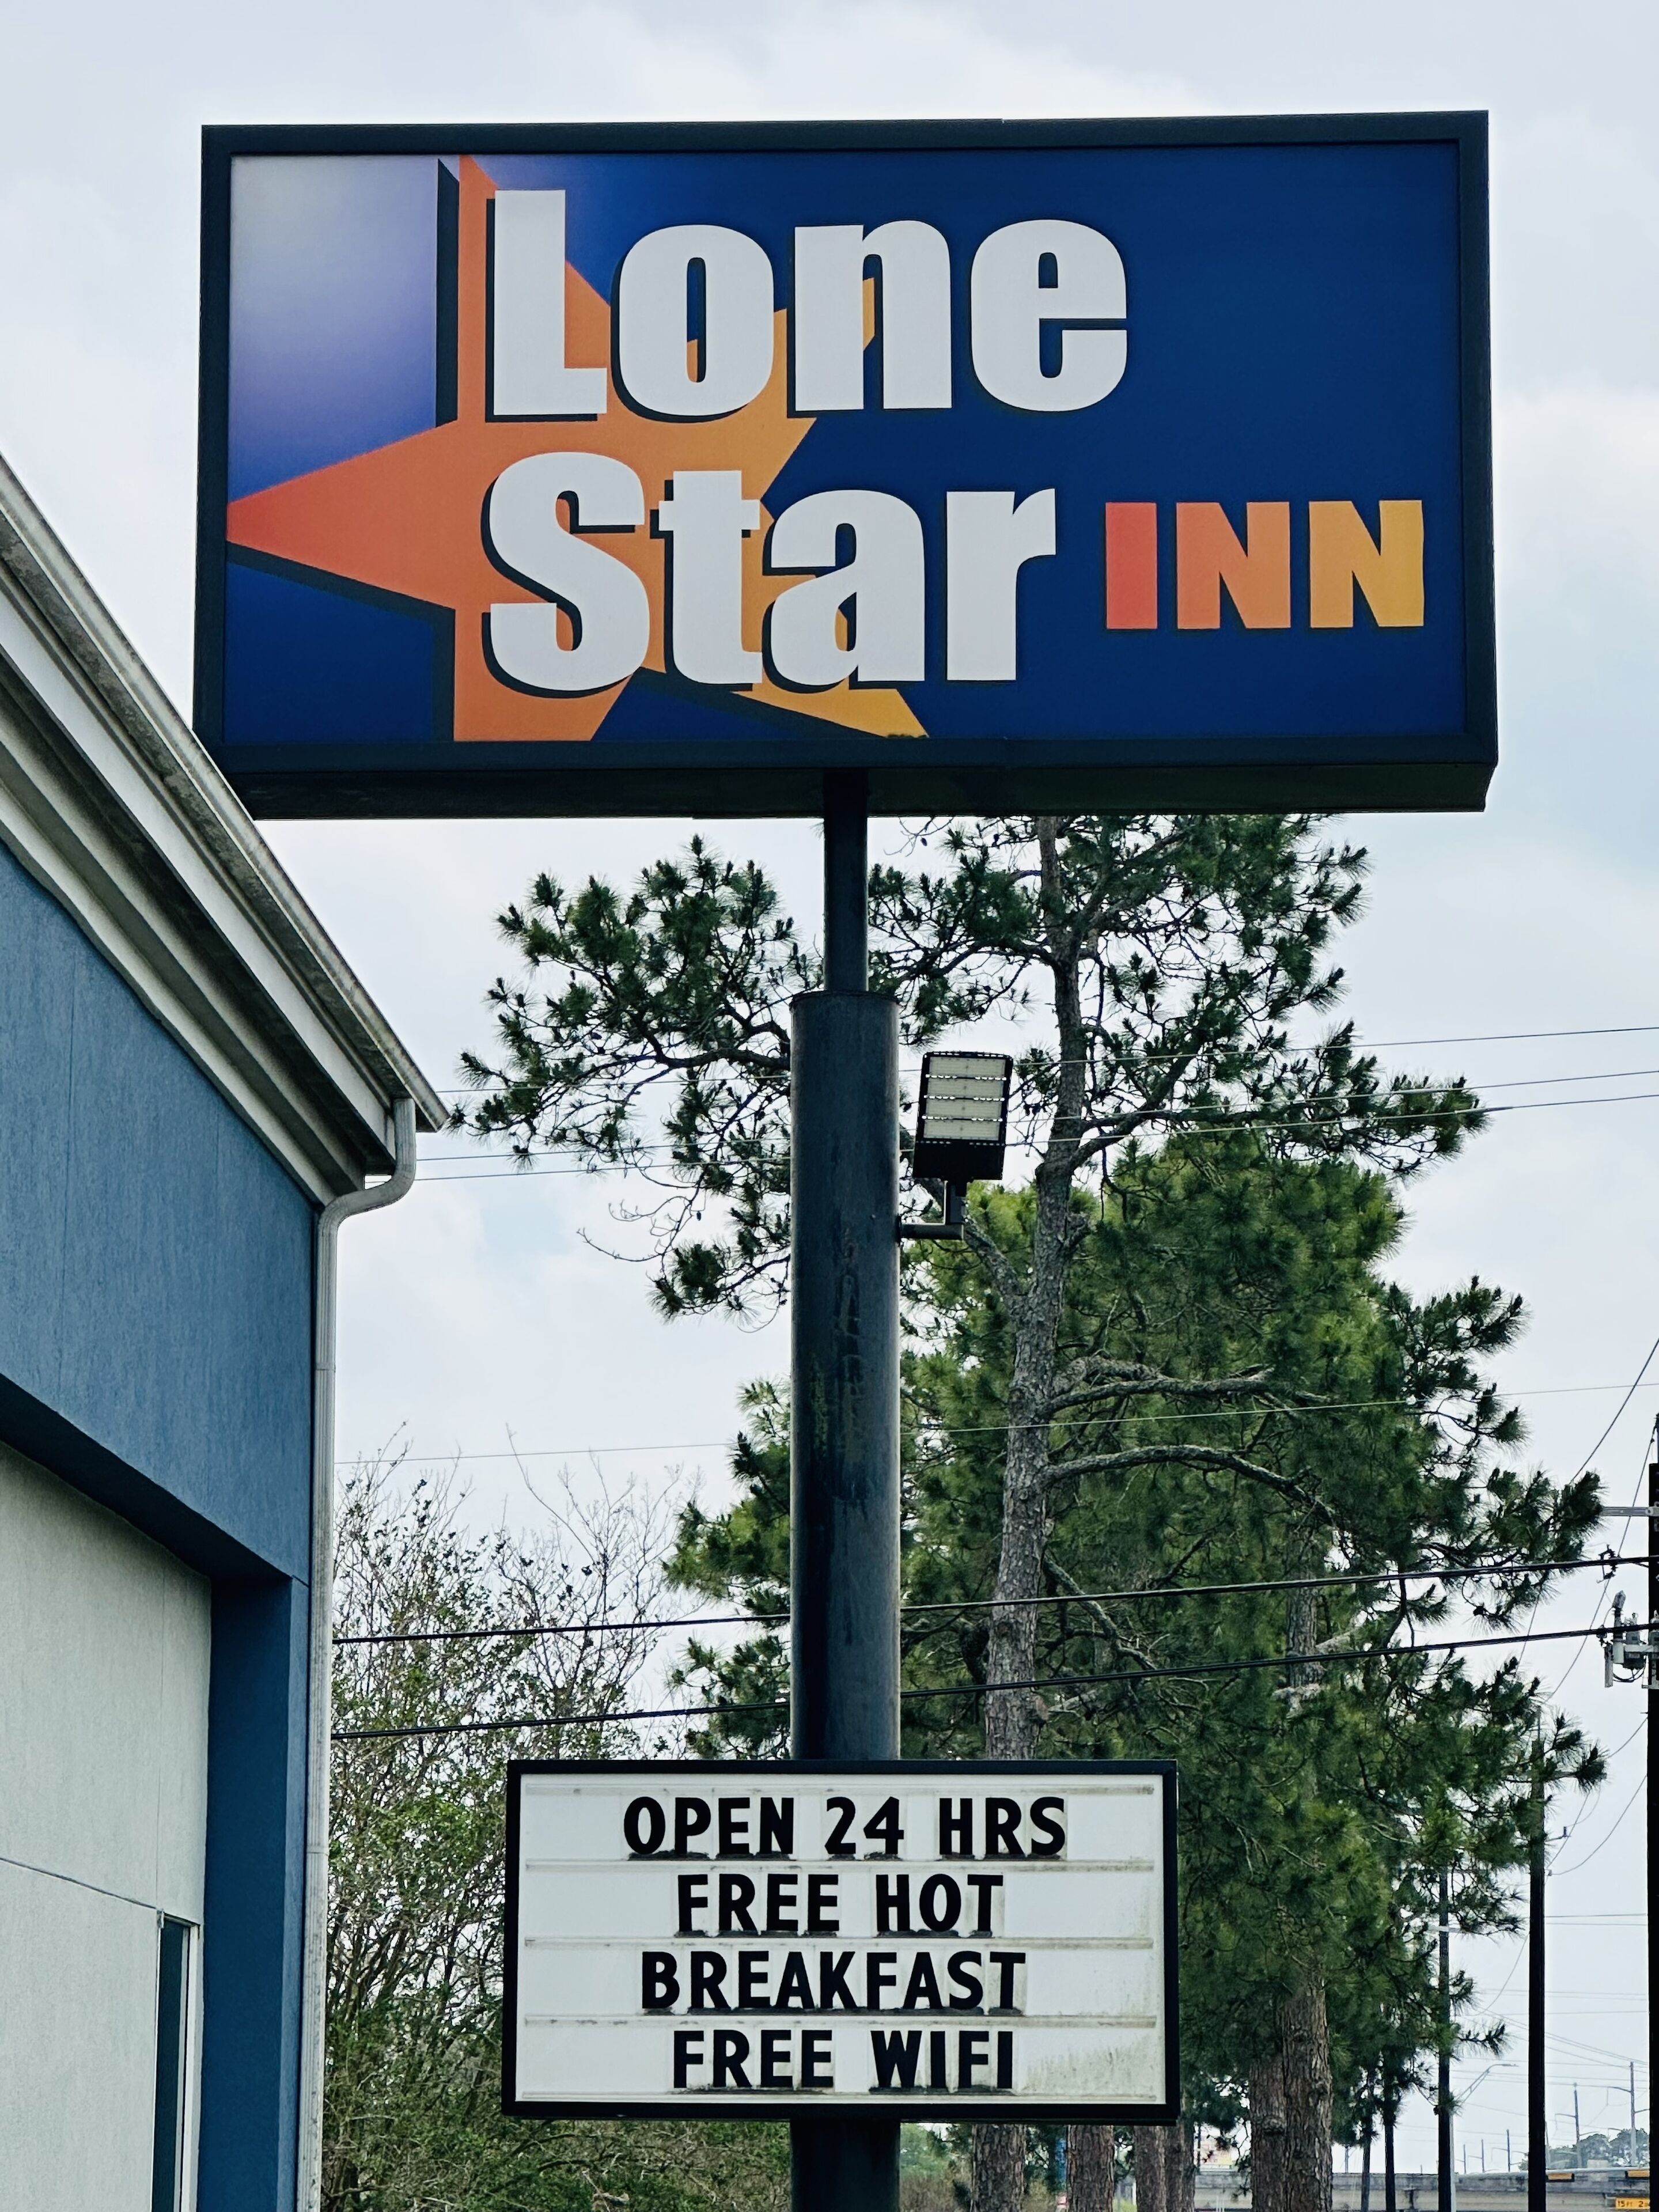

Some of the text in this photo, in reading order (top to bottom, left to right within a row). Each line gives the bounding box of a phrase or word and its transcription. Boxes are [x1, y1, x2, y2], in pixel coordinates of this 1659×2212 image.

[493, 190, 1127, 415] Lone
[490, 452, 1424, 690] Star INN
[624, 1797, 1066, 1856] OPEN 24 HRS
[678, 1874, 1004, 1932] FREE HOT
[642, 1951, 1026, 2009] BREAKFAST
[674, 2030, 1013, 2088] FREE WIFI
